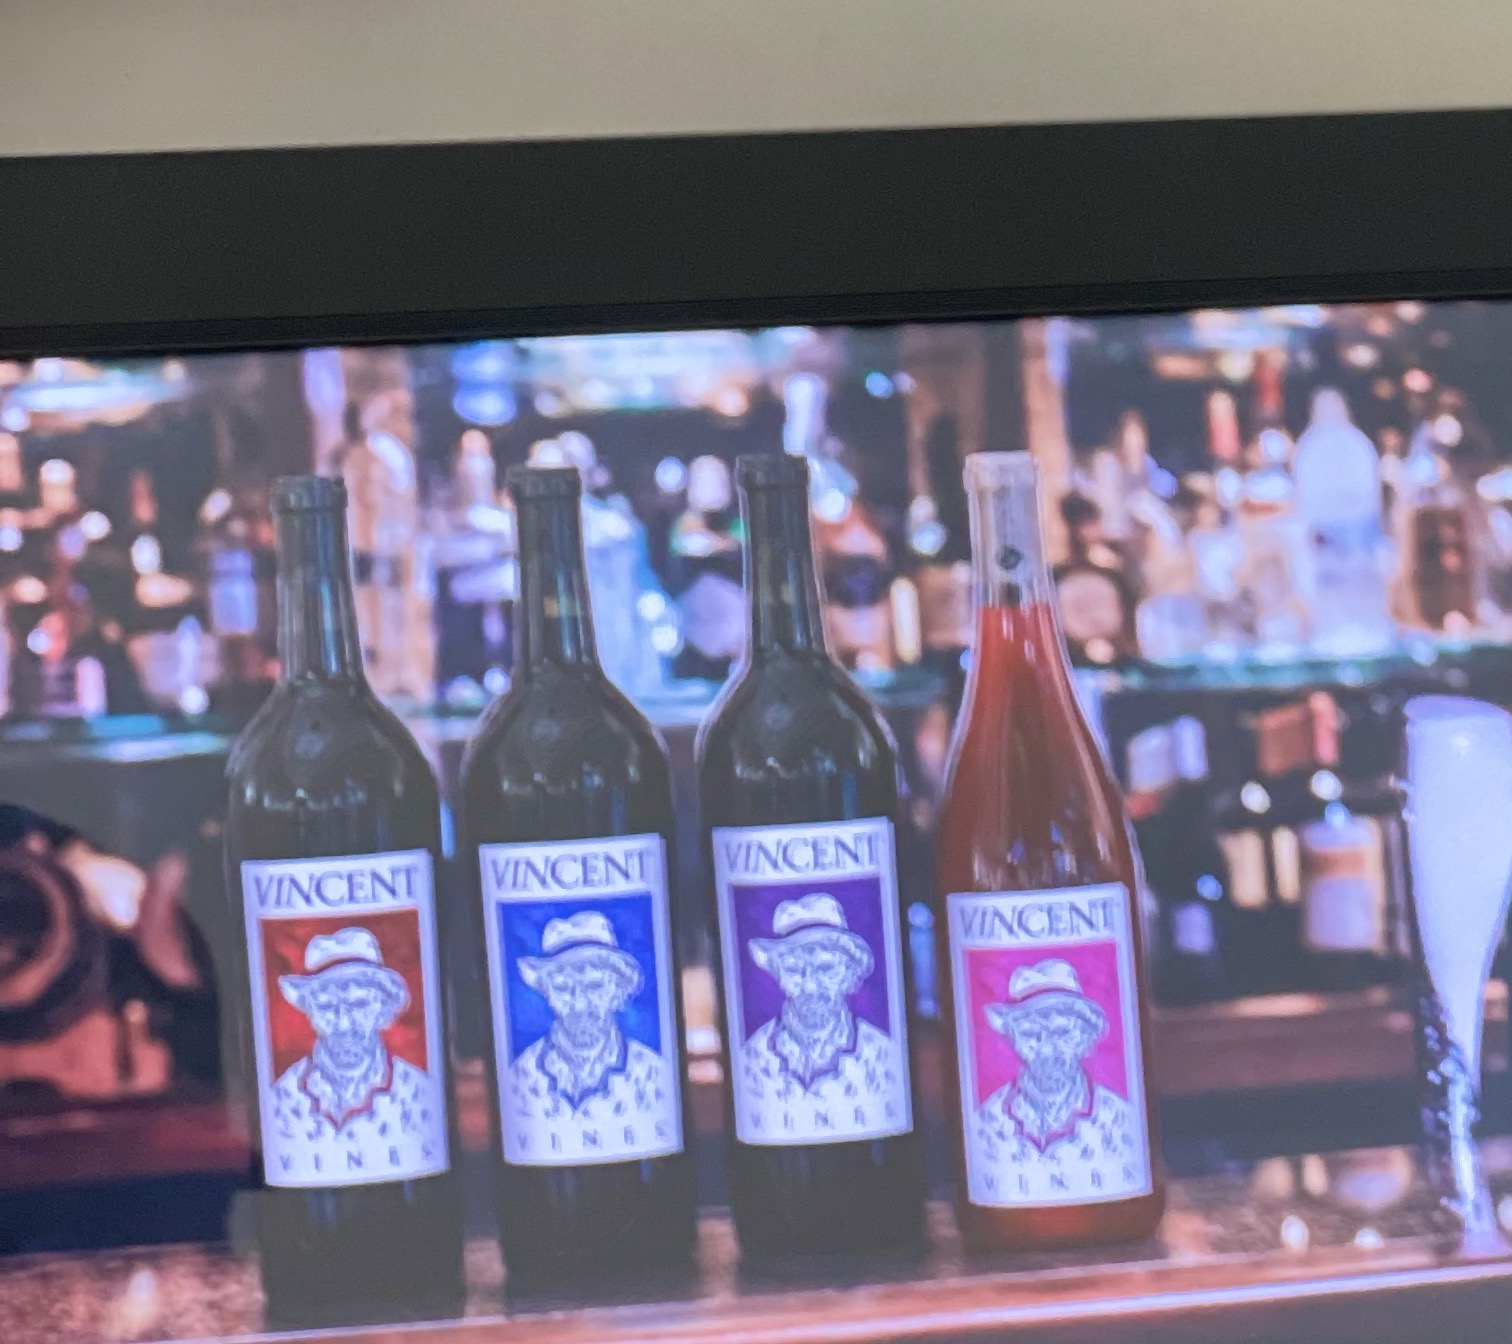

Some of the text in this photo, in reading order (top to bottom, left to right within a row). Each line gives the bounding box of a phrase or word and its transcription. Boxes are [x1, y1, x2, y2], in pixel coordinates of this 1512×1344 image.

[490, 848, 652, 893] VINCENT
[722, 829, 880, 874] VINCENT
[253, 865, 419, 909] VINCENT
[960, 893, 1115, 938] VINCENT
